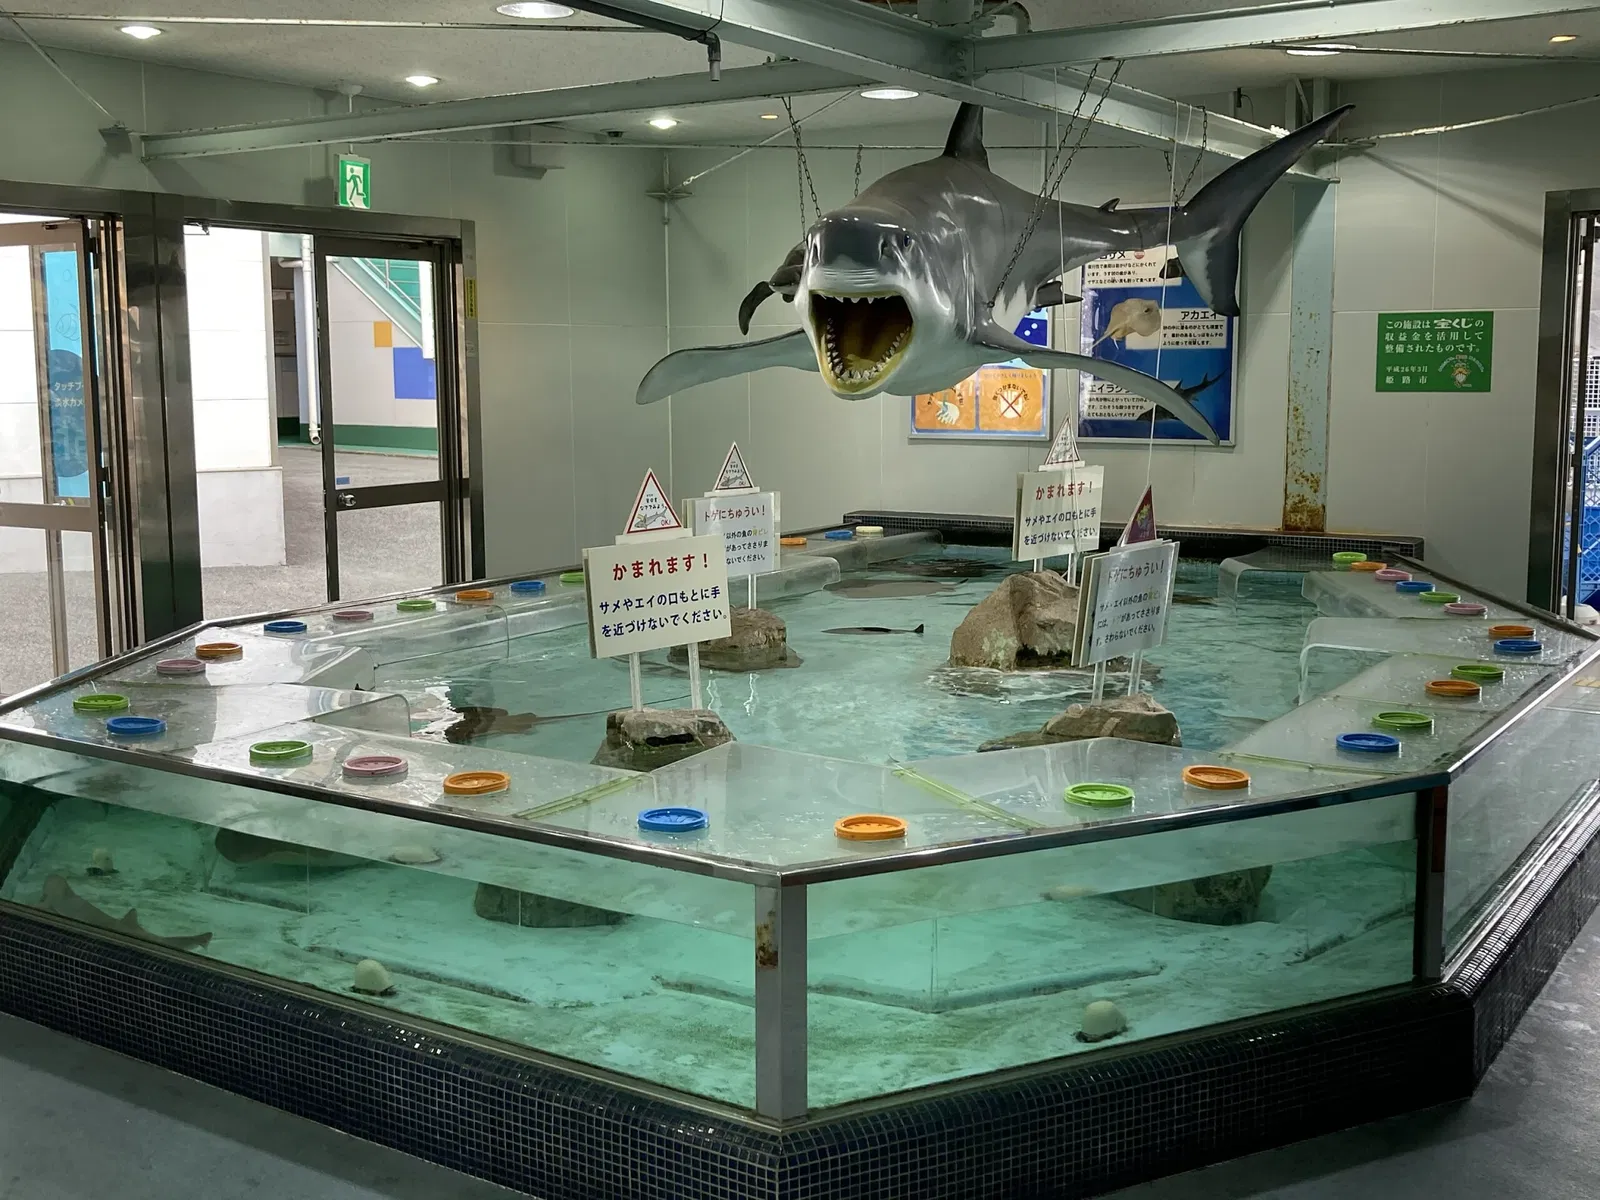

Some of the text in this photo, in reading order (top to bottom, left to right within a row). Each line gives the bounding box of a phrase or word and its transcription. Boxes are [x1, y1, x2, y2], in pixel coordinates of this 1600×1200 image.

[1180, 310, 1217, 320] アカエイ
[1386, 318, 1484, 330] この施設は宝くじの
[1385, 331, 1484, 341] 収益金を活用して
[1385, 343, 1480, 354] 整備されたものです。
[1386, 376, 1428, 384] 姫路市
[1036, 481, 1092, 500] かまれます！
[704, 505, 765, 522] トゲにちゅうい！
[1026, 507, 1096, 526] サメやエイの口もとに手
[612, 554, 708, 580] かまれます！
[599, 586, 720, 614] サメやエイの口もとに手
[602, 608, 727, 638] を近づけないでください。
